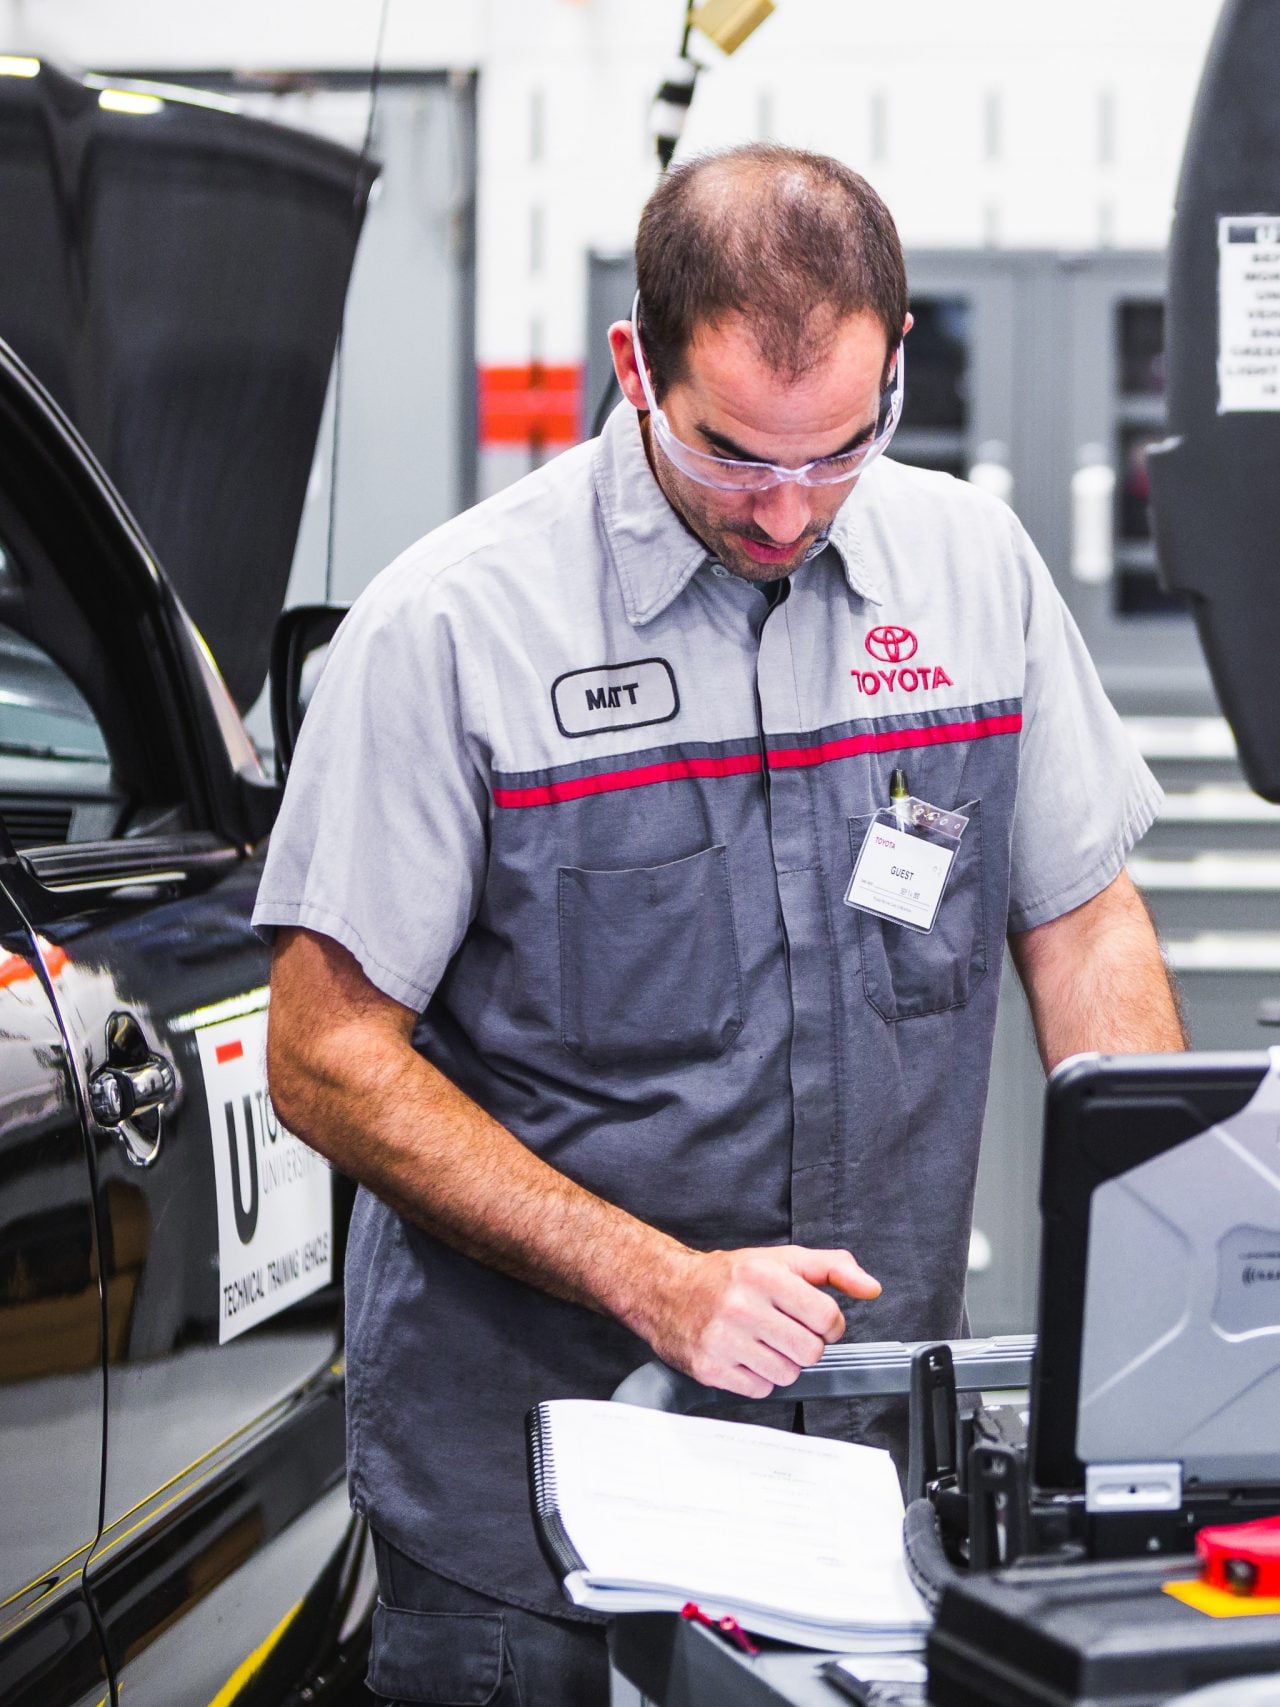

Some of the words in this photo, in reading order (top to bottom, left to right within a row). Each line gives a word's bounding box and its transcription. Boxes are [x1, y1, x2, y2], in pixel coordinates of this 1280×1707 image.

[851, 665, 954, 696] TOYOTA
[585, 682, 640, 711] MATT
[875, 836, 896, 849] TOYOTA
[890, 865, 914, 881] GUEST
[223, 1267, 265, 1319] TECHNICAL
[267, 1247, 299, 1295] TRAINING
[301, 1231, 328, 1272] VEHICLE
